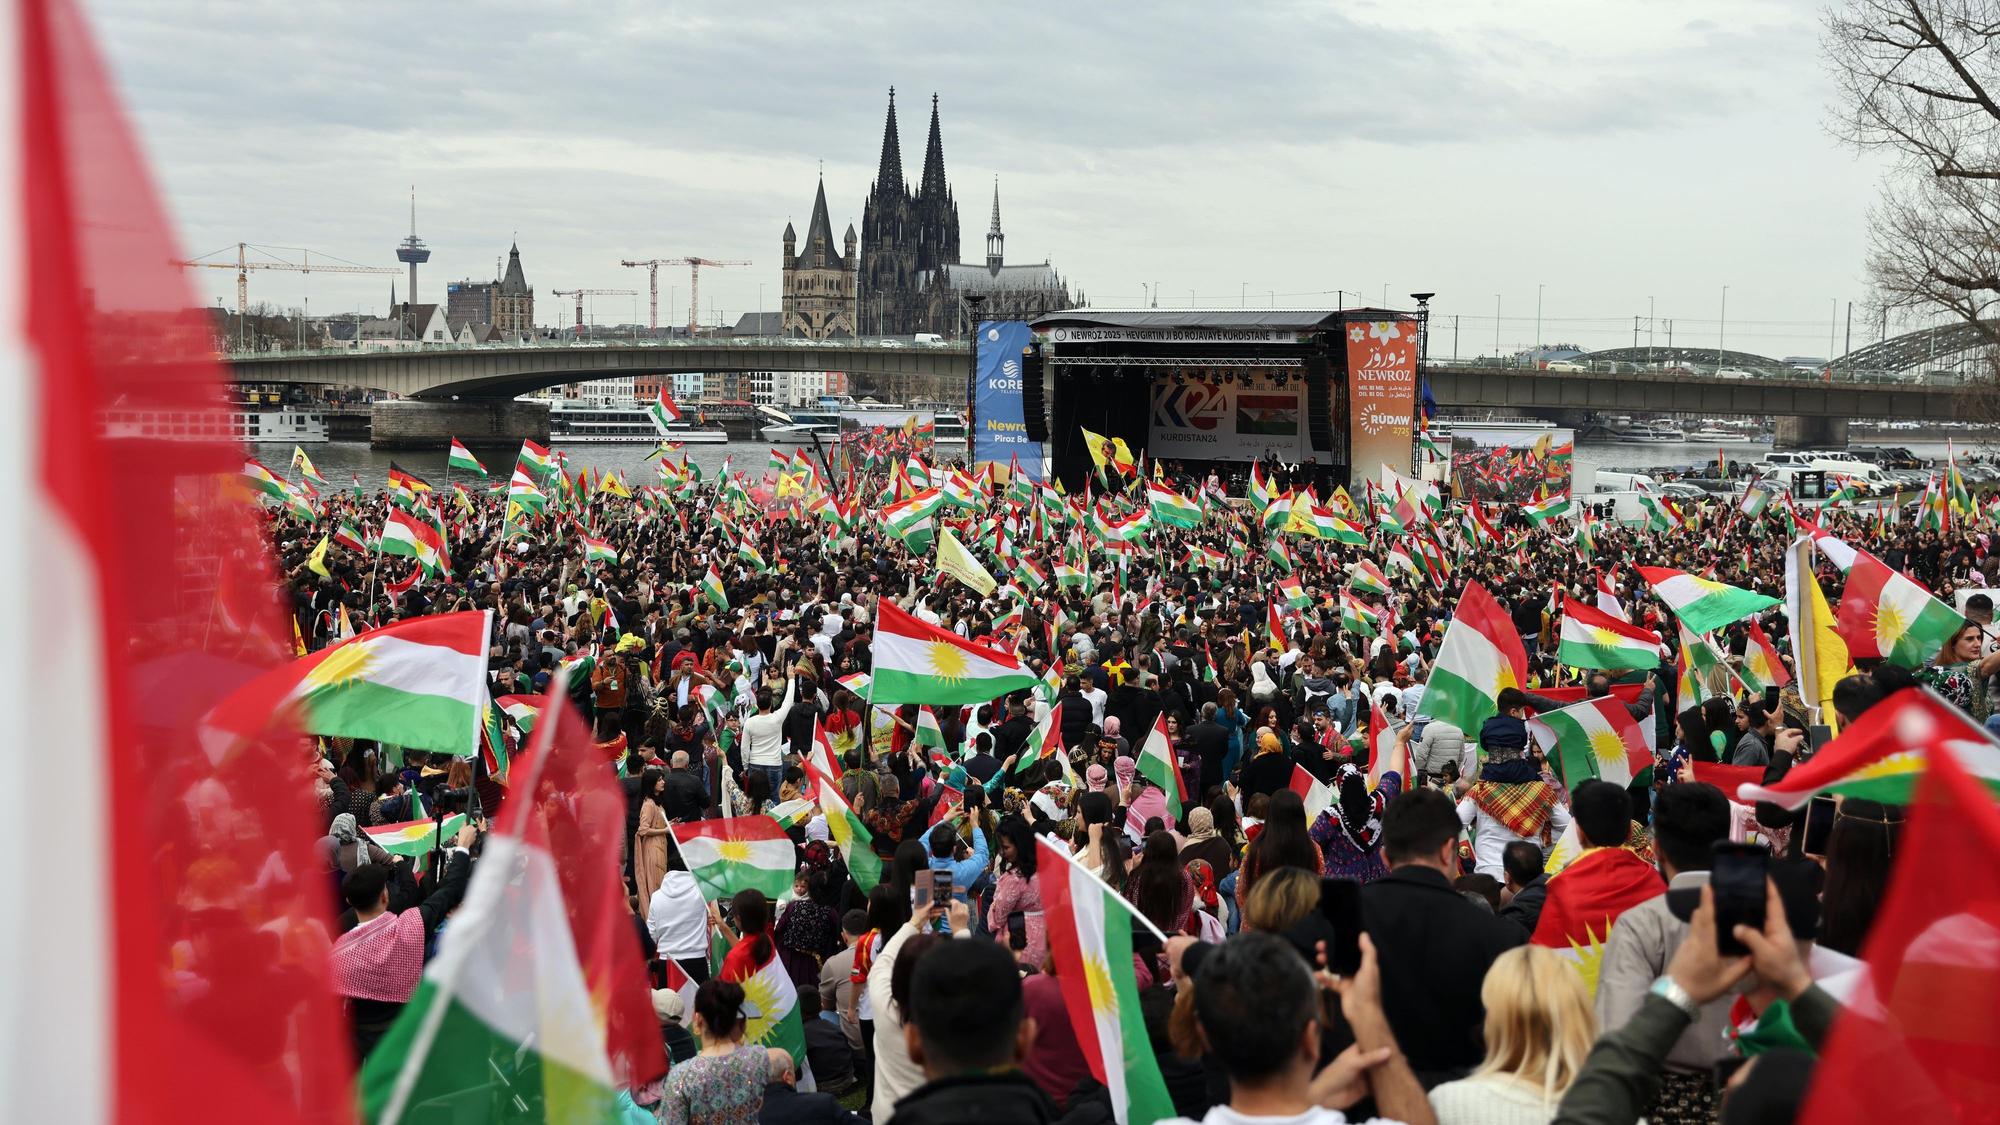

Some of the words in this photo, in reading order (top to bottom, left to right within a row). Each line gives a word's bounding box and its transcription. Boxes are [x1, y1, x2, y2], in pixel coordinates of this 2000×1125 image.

[1071, 330, 1102, 340] NEWROZ
[1103, 330, 1121, 339] 2025
[1126, 330, 1165, 340] HEVGIRTIN
[1166, 331, 1172, 340] JI
[1173, 331, 1183, 340] BO
[1363, 346, 1406, 368] نەورۆز
[1358, 370, 1411, 381] NEWROZ
[1371, 413, 1410, 425] RÛDAW
[1393, 427, 1411, 437] 2725
[994, 434, 1016, 443] Piroz
[1017, 435, 1028, 444] Be
[1160, 433, 1218, 443] KURDISTAN24
